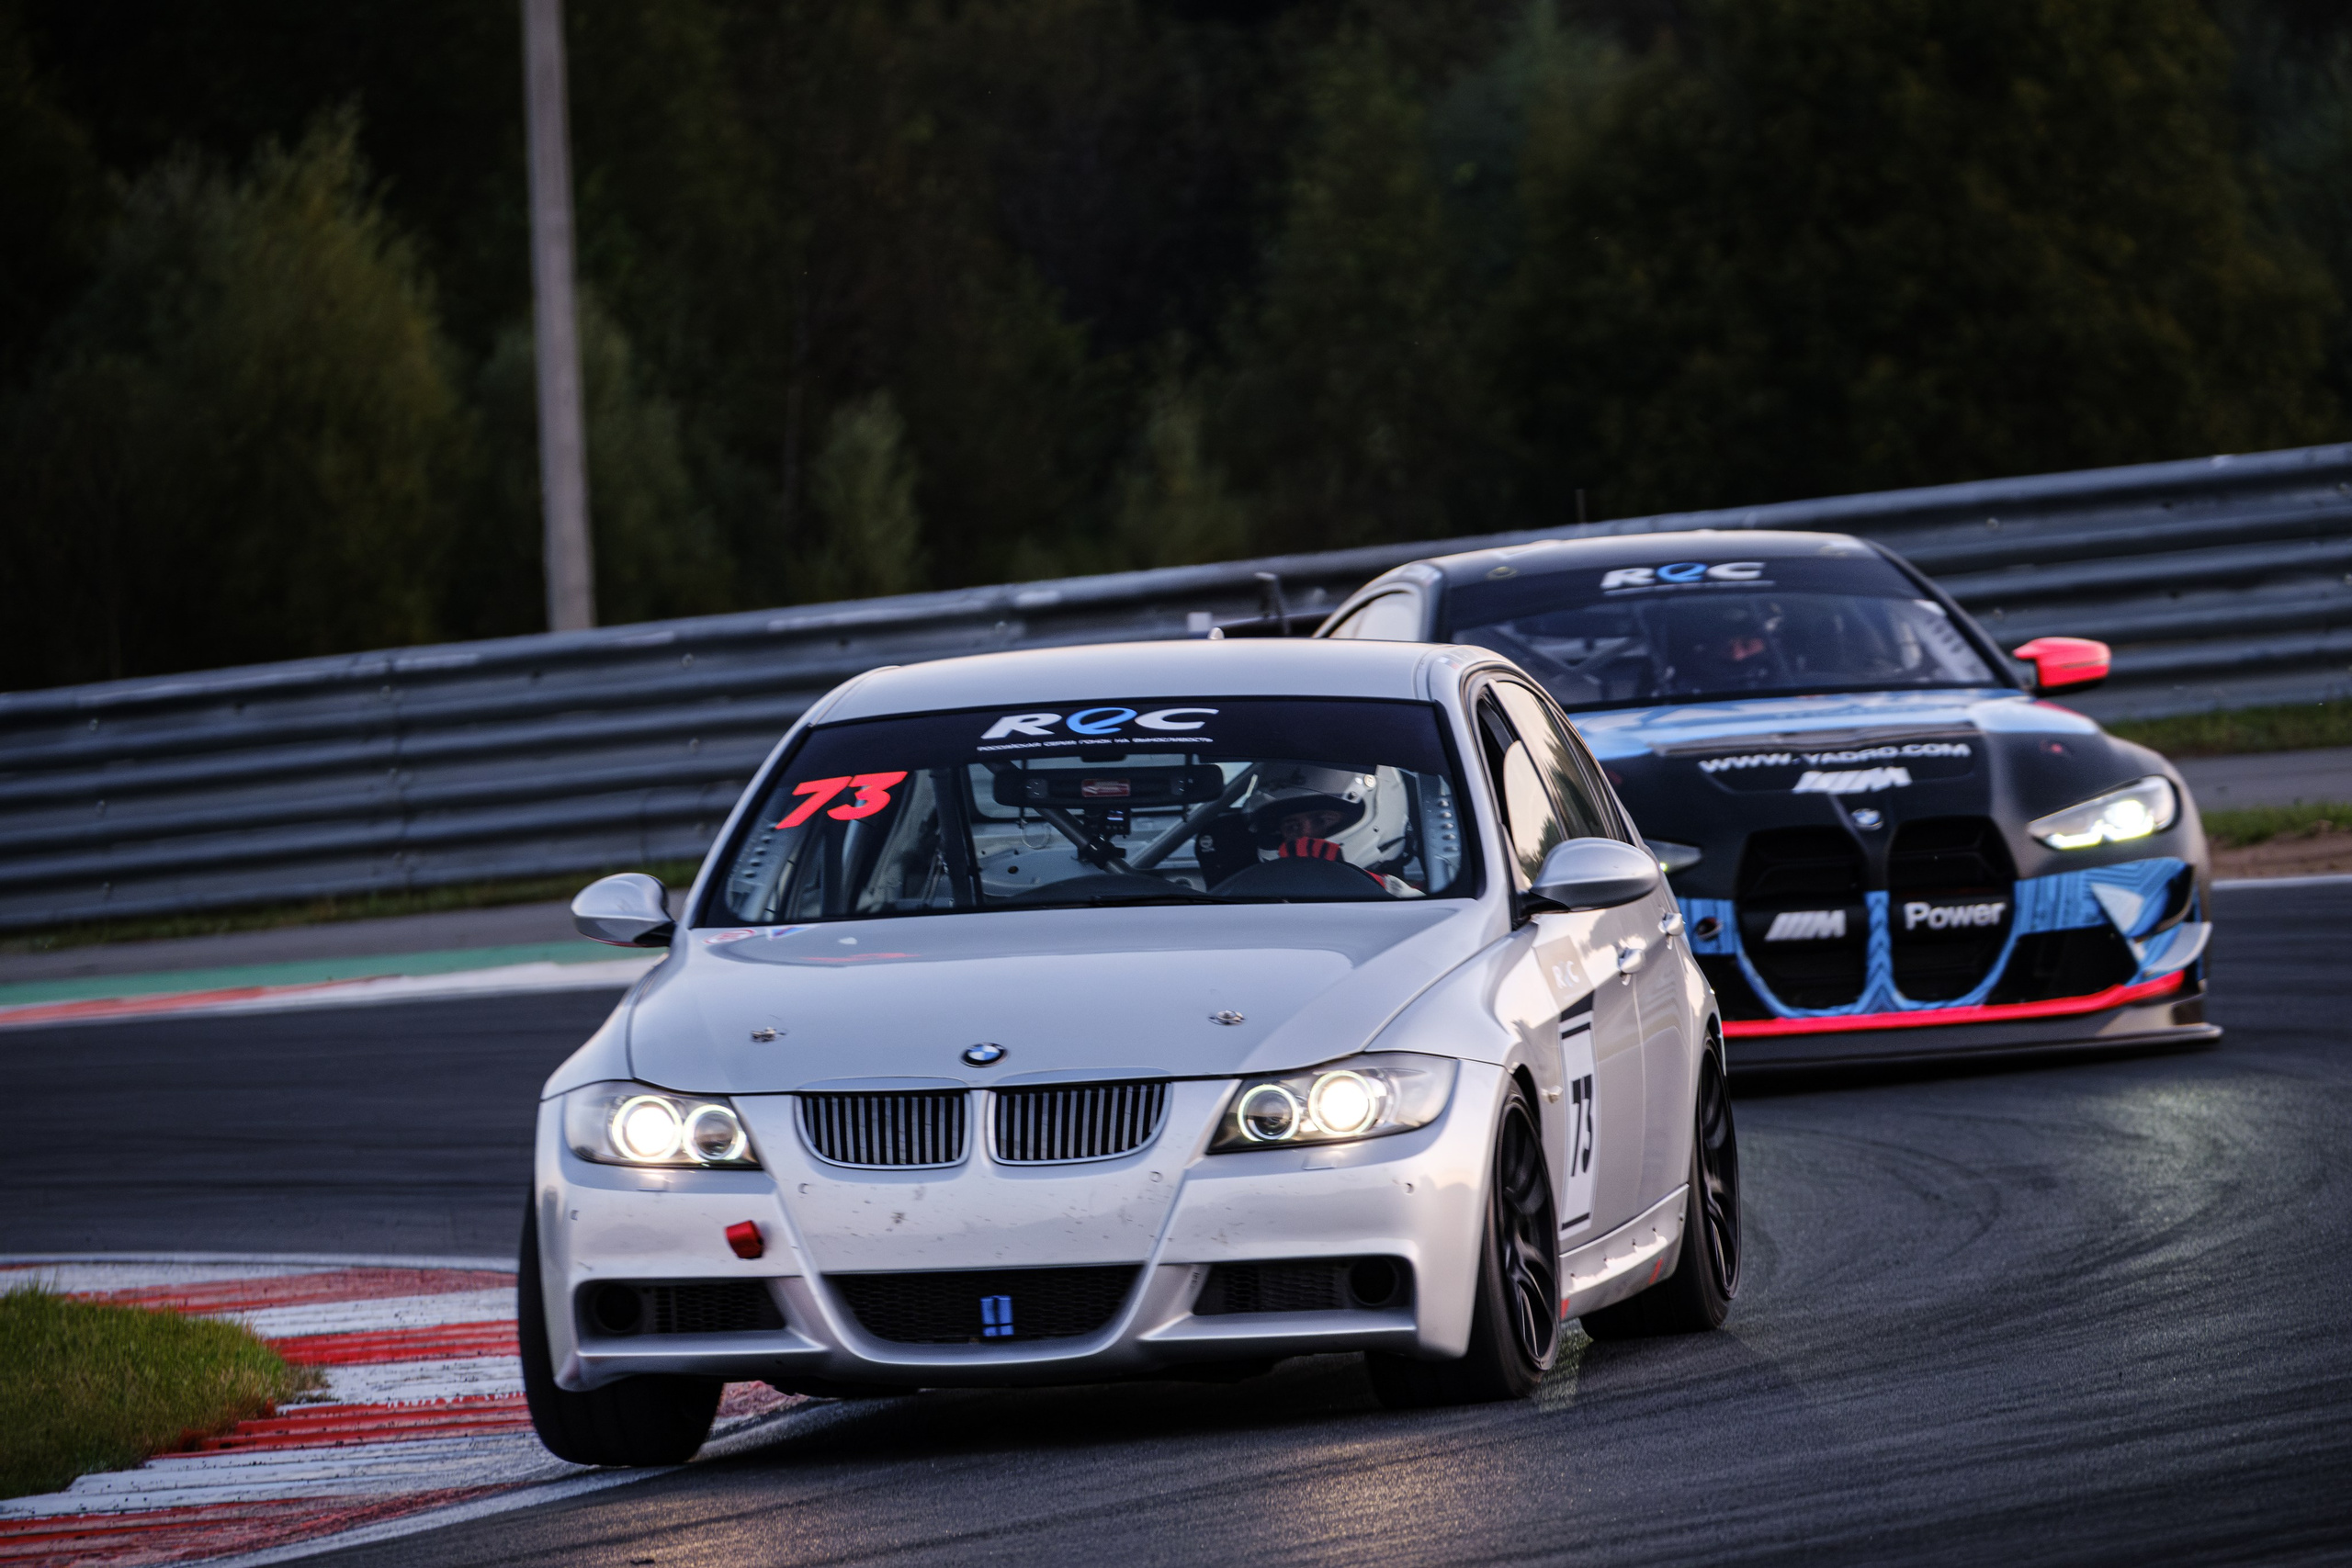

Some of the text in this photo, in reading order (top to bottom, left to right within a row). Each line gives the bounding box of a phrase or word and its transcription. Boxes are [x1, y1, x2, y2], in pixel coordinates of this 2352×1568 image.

[774, 771, 909, 830] 73
[1904, 901, 2007, 931] Power
[1570, 1073, 1593, 1177] 73
